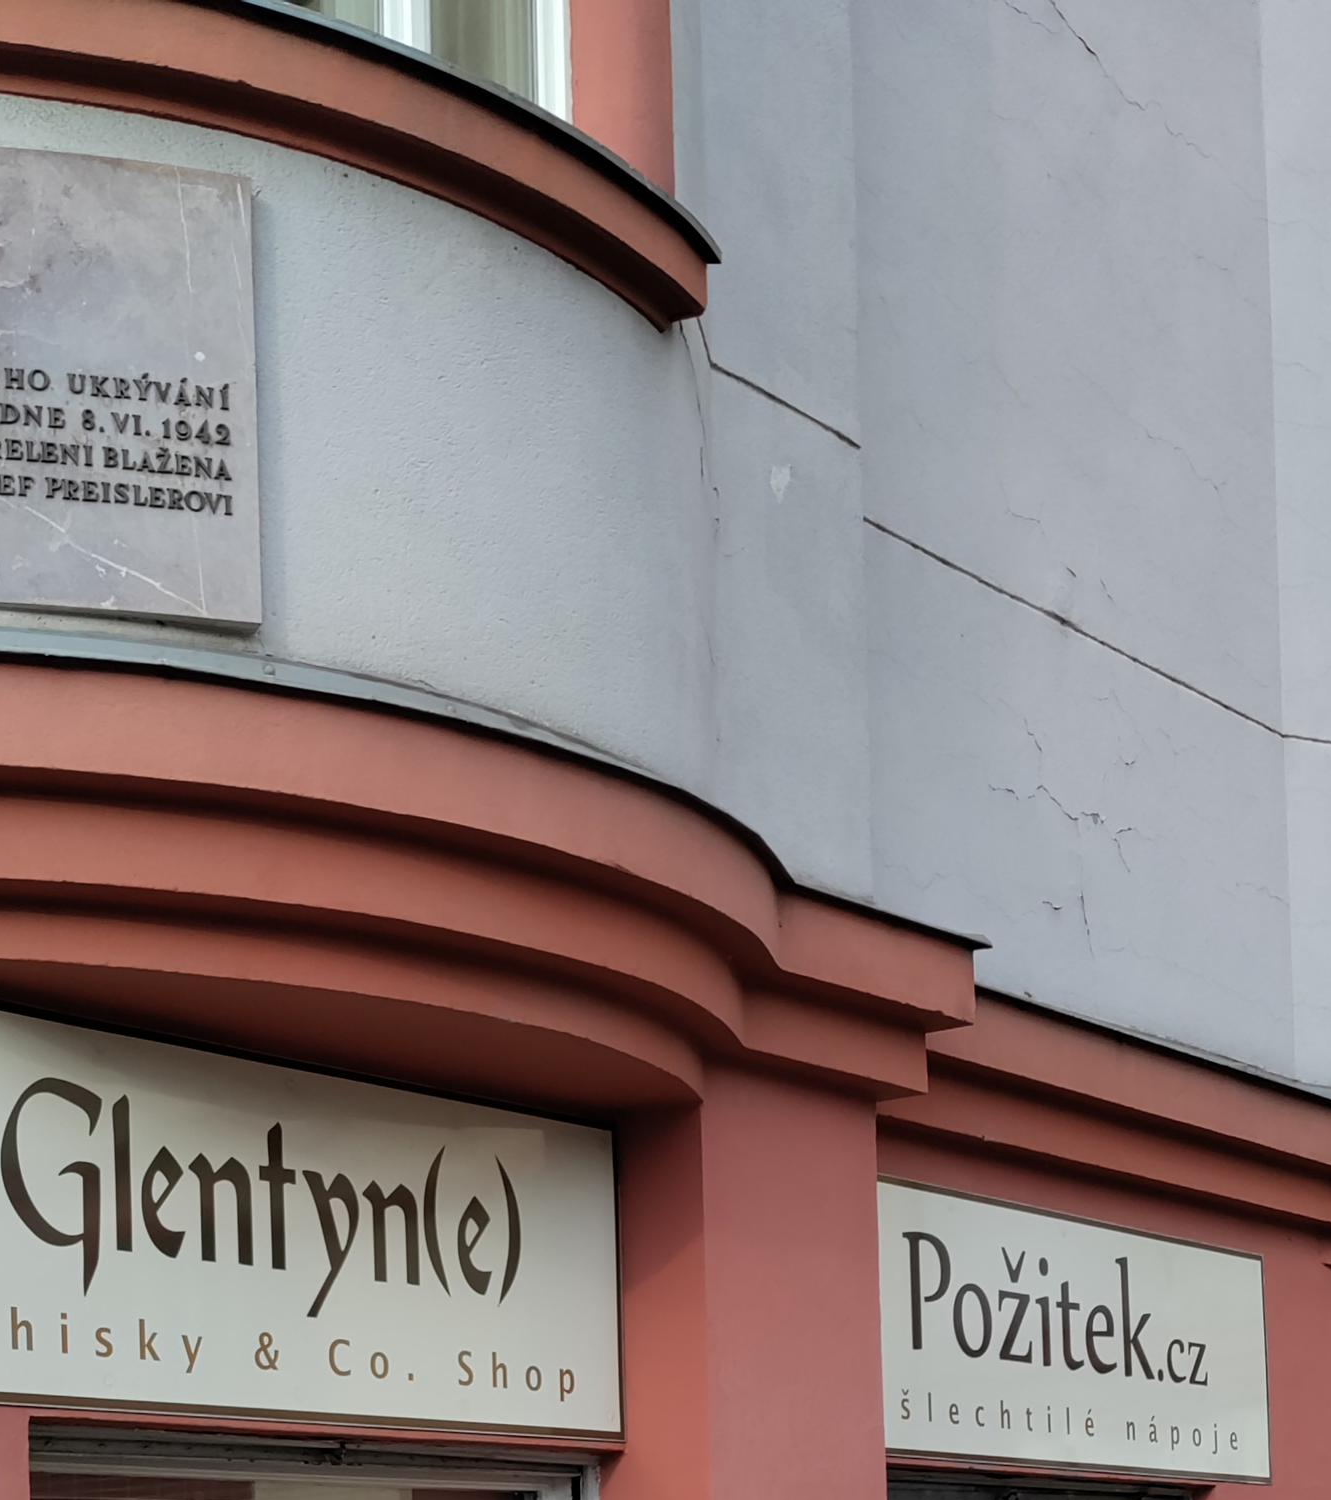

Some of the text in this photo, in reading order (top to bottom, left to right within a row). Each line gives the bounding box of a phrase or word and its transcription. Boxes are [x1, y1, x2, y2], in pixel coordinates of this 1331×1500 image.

[0, 402, 65, 430] DNE
[67, 372, 230, 411] UKRÝVÁNÍ
[102, 446, 233, 481] BLAŽENA
[44, 476, 233, 516] PREISLEROVI
[0, 1075, 521, 1319] Glentyn(e)
[902, 1231, 1208, 1387] Požitek.cz
[254, 1331, 280, 1371] &
[328, 1338, 415, 1382] Co.
[458, 1350, 577, 1401] Shop
[901, 1388, 1239, 1454] šlechtilé nápoje
